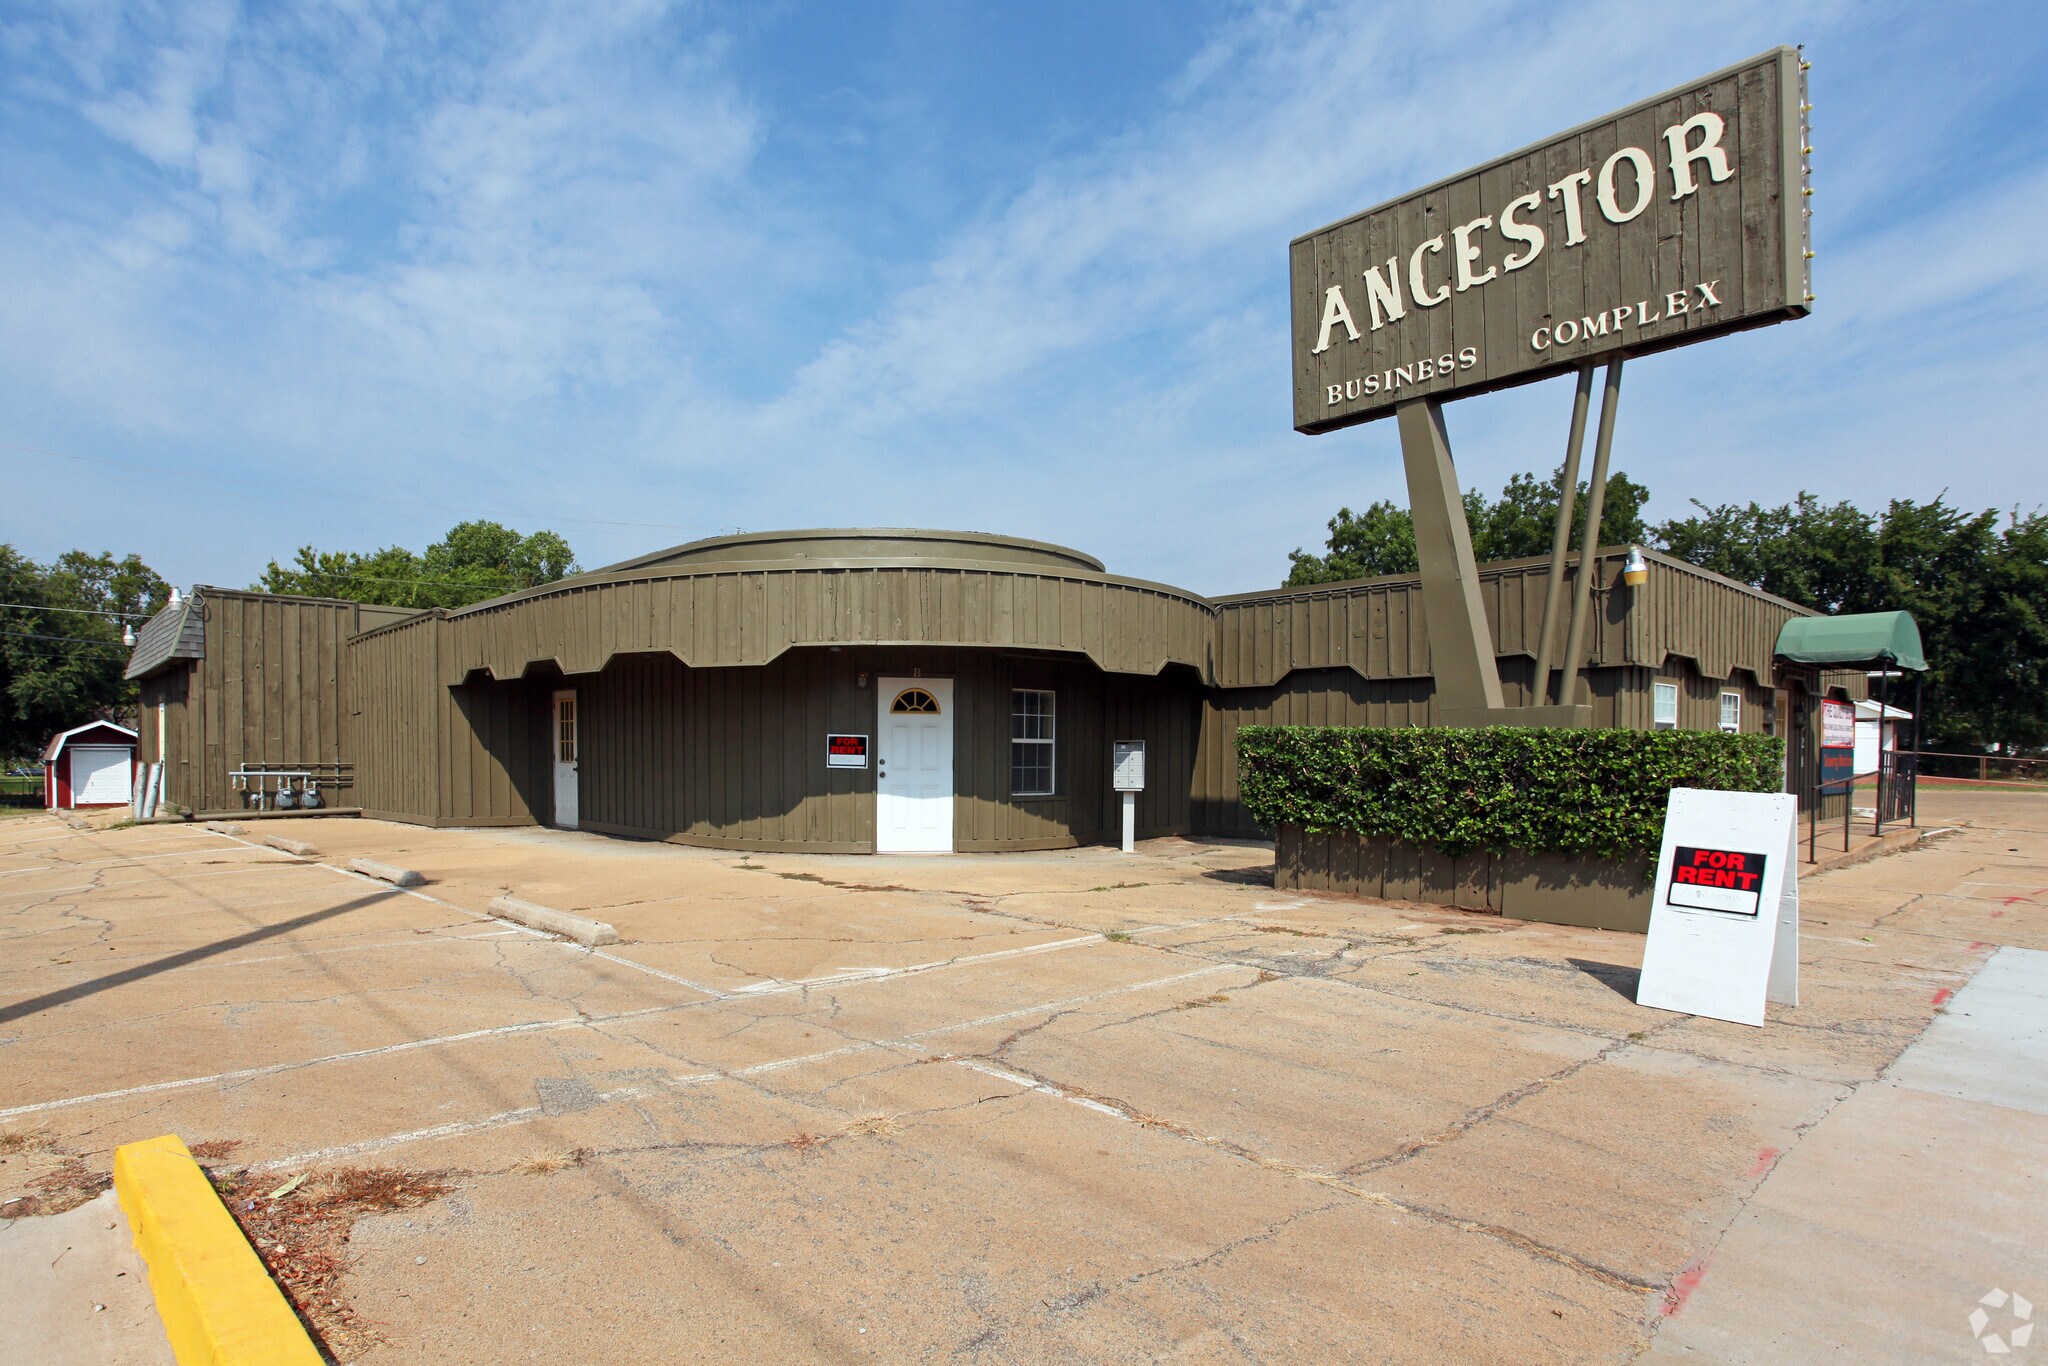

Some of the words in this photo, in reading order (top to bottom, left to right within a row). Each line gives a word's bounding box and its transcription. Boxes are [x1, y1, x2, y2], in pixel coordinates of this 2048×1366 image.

[1312, 111, 1736, 355] ANCESTOR
[1327, 346, 1478, 406] BUSINESS
[1531, 279, 1723, 352] COMPLEX
[831, 745, 864, 754] RENT
[836, 737, 859, 746] FOR
[1693, 849, 1746, 871] FOR
[1676, 865, 1759, 890] RENT
